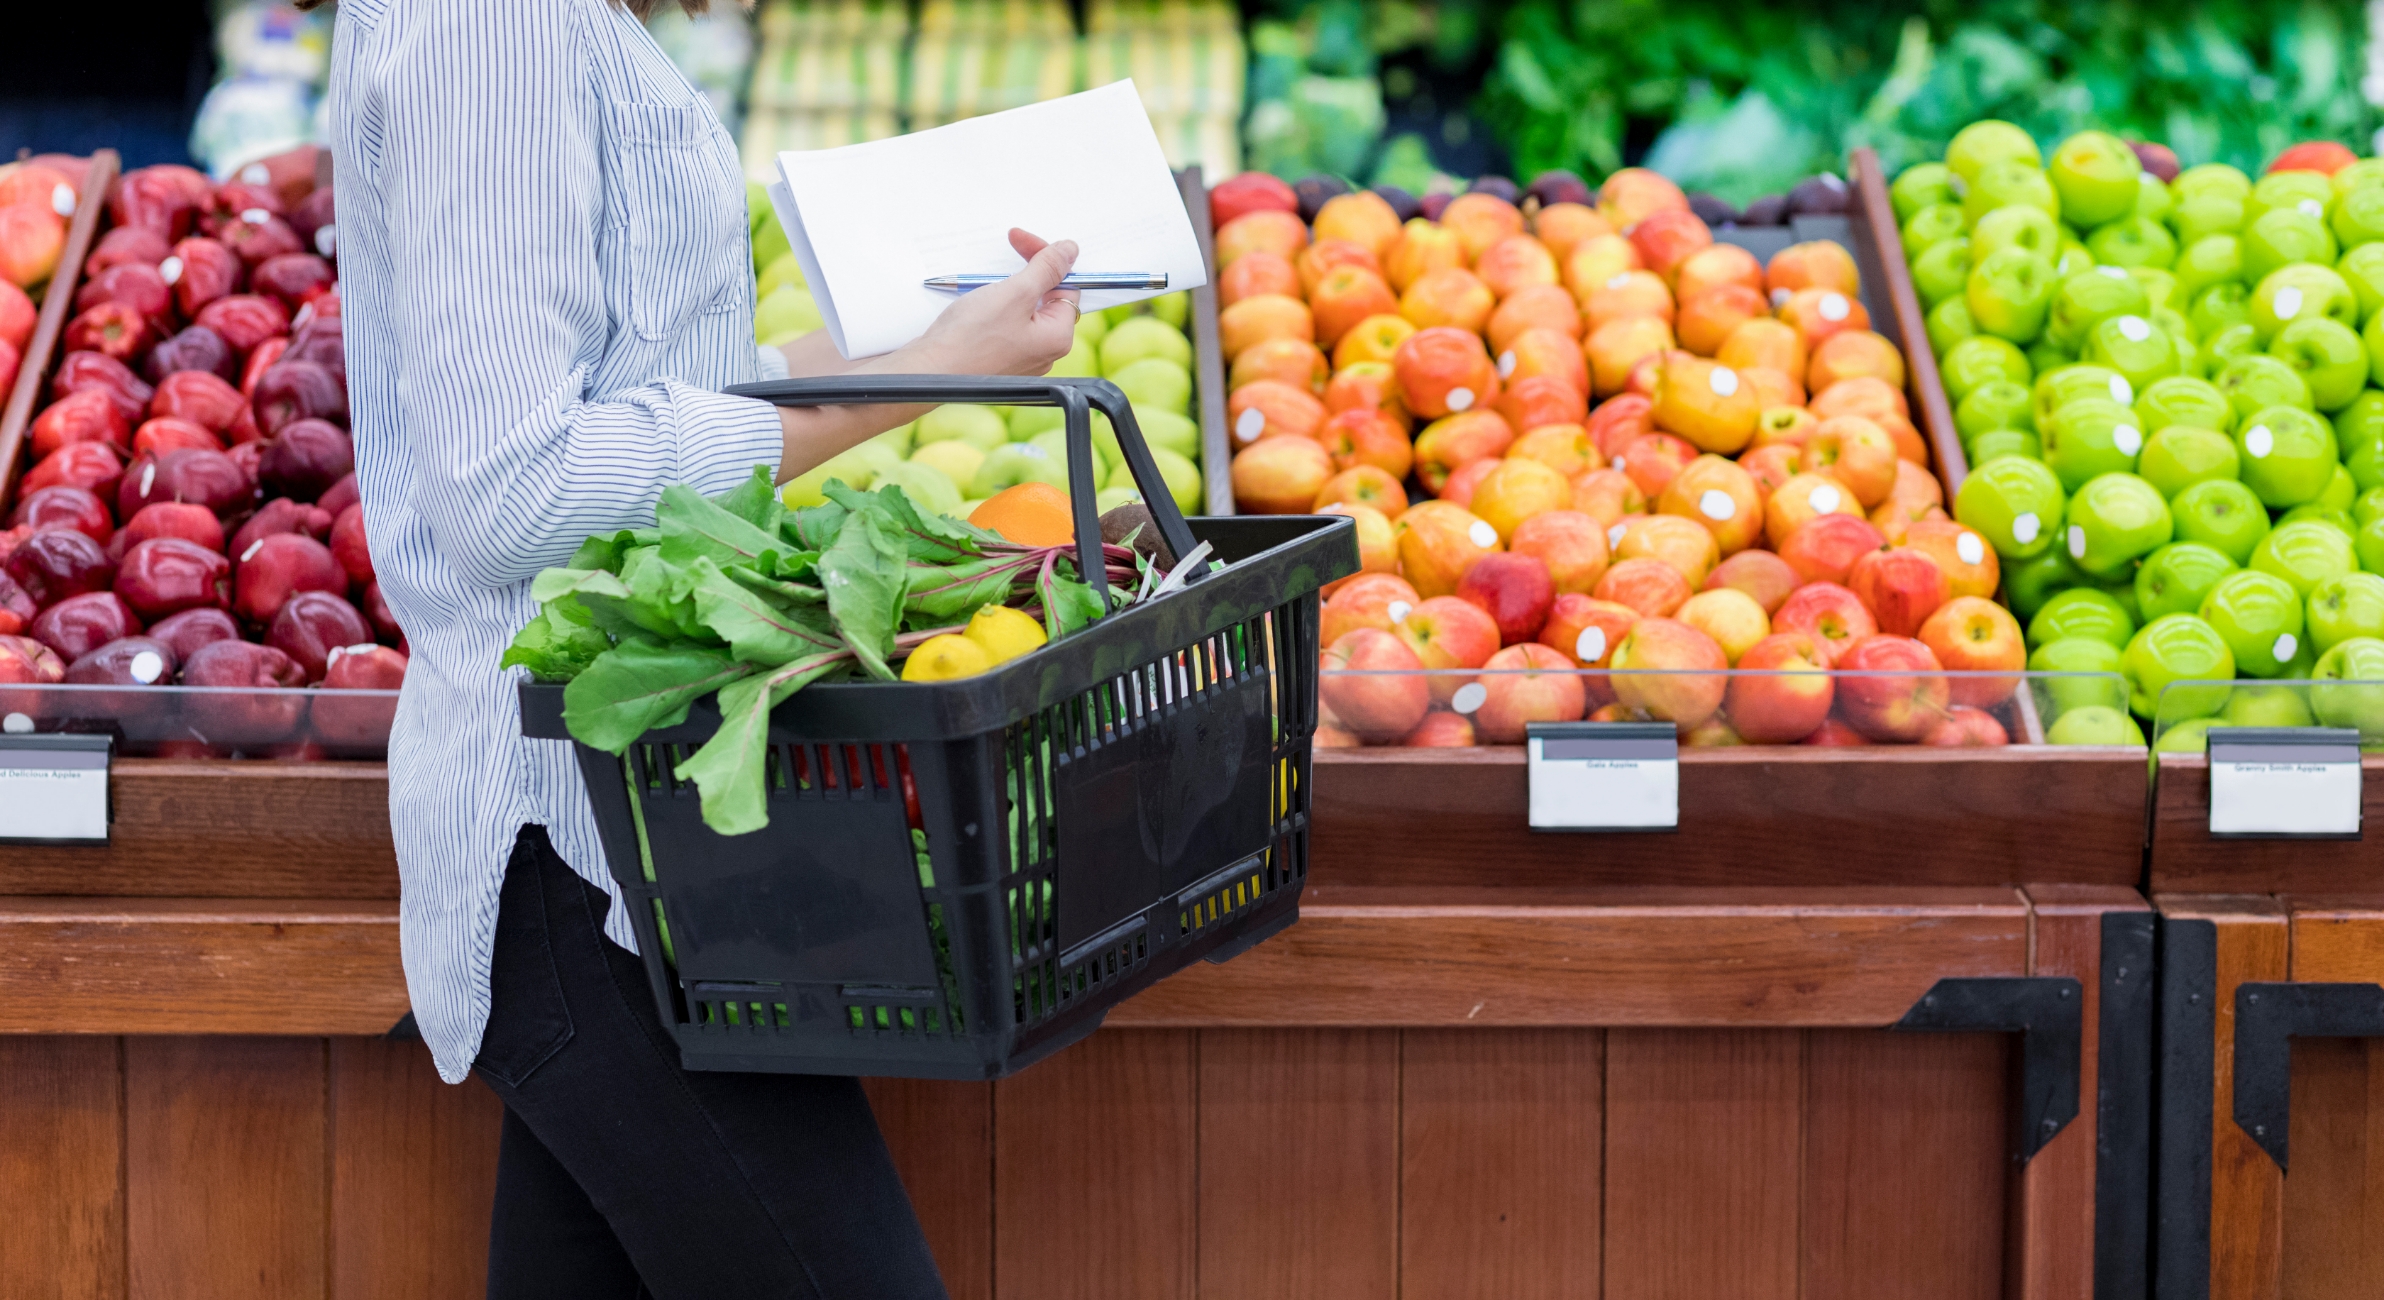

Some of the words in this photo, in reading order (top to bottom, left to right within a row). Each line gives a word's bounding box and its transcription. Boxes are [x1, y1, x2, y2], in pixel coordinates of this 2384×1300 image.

[1609, 761, 1638, 769] Apples
[2235, 764, 2265, 772] Granny
[2296, 764, 2326, 772] Apples
[9, 770, 49, 778] Delicious
[51, 770, 81, 779] Apples
